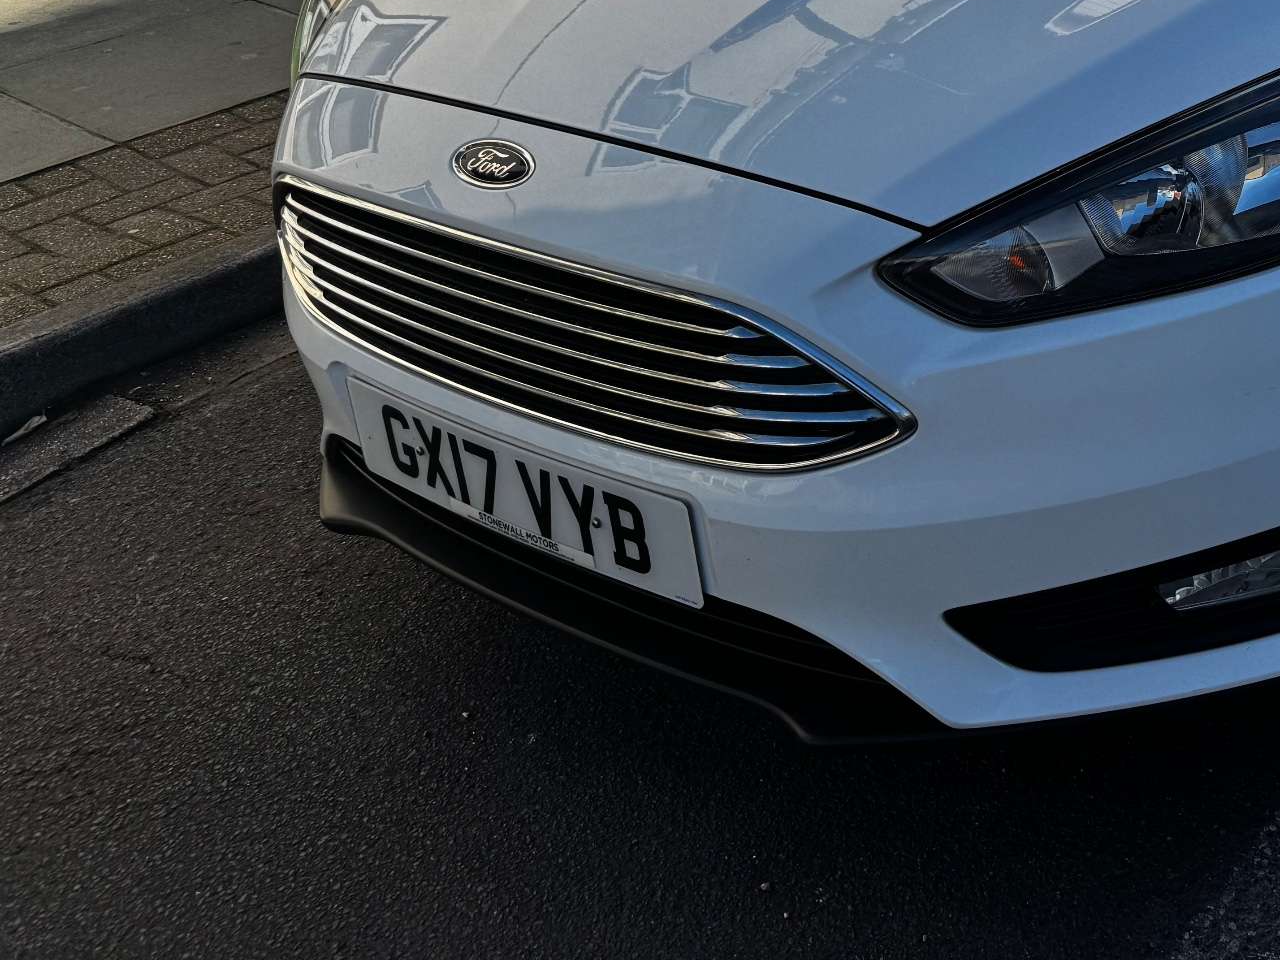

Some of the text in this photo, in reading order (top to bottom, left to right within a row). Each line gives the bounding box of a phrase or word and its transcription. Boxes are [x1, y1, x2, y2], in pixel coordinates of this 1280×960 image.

[467, 148, 517, 178] Ford
[381, 404, 497, 515] GX17
[515, 459, 652, 575] VYB
[478, 511, 524, 538] STONEWALL
[526, 531, 560, 552] MOTORS
